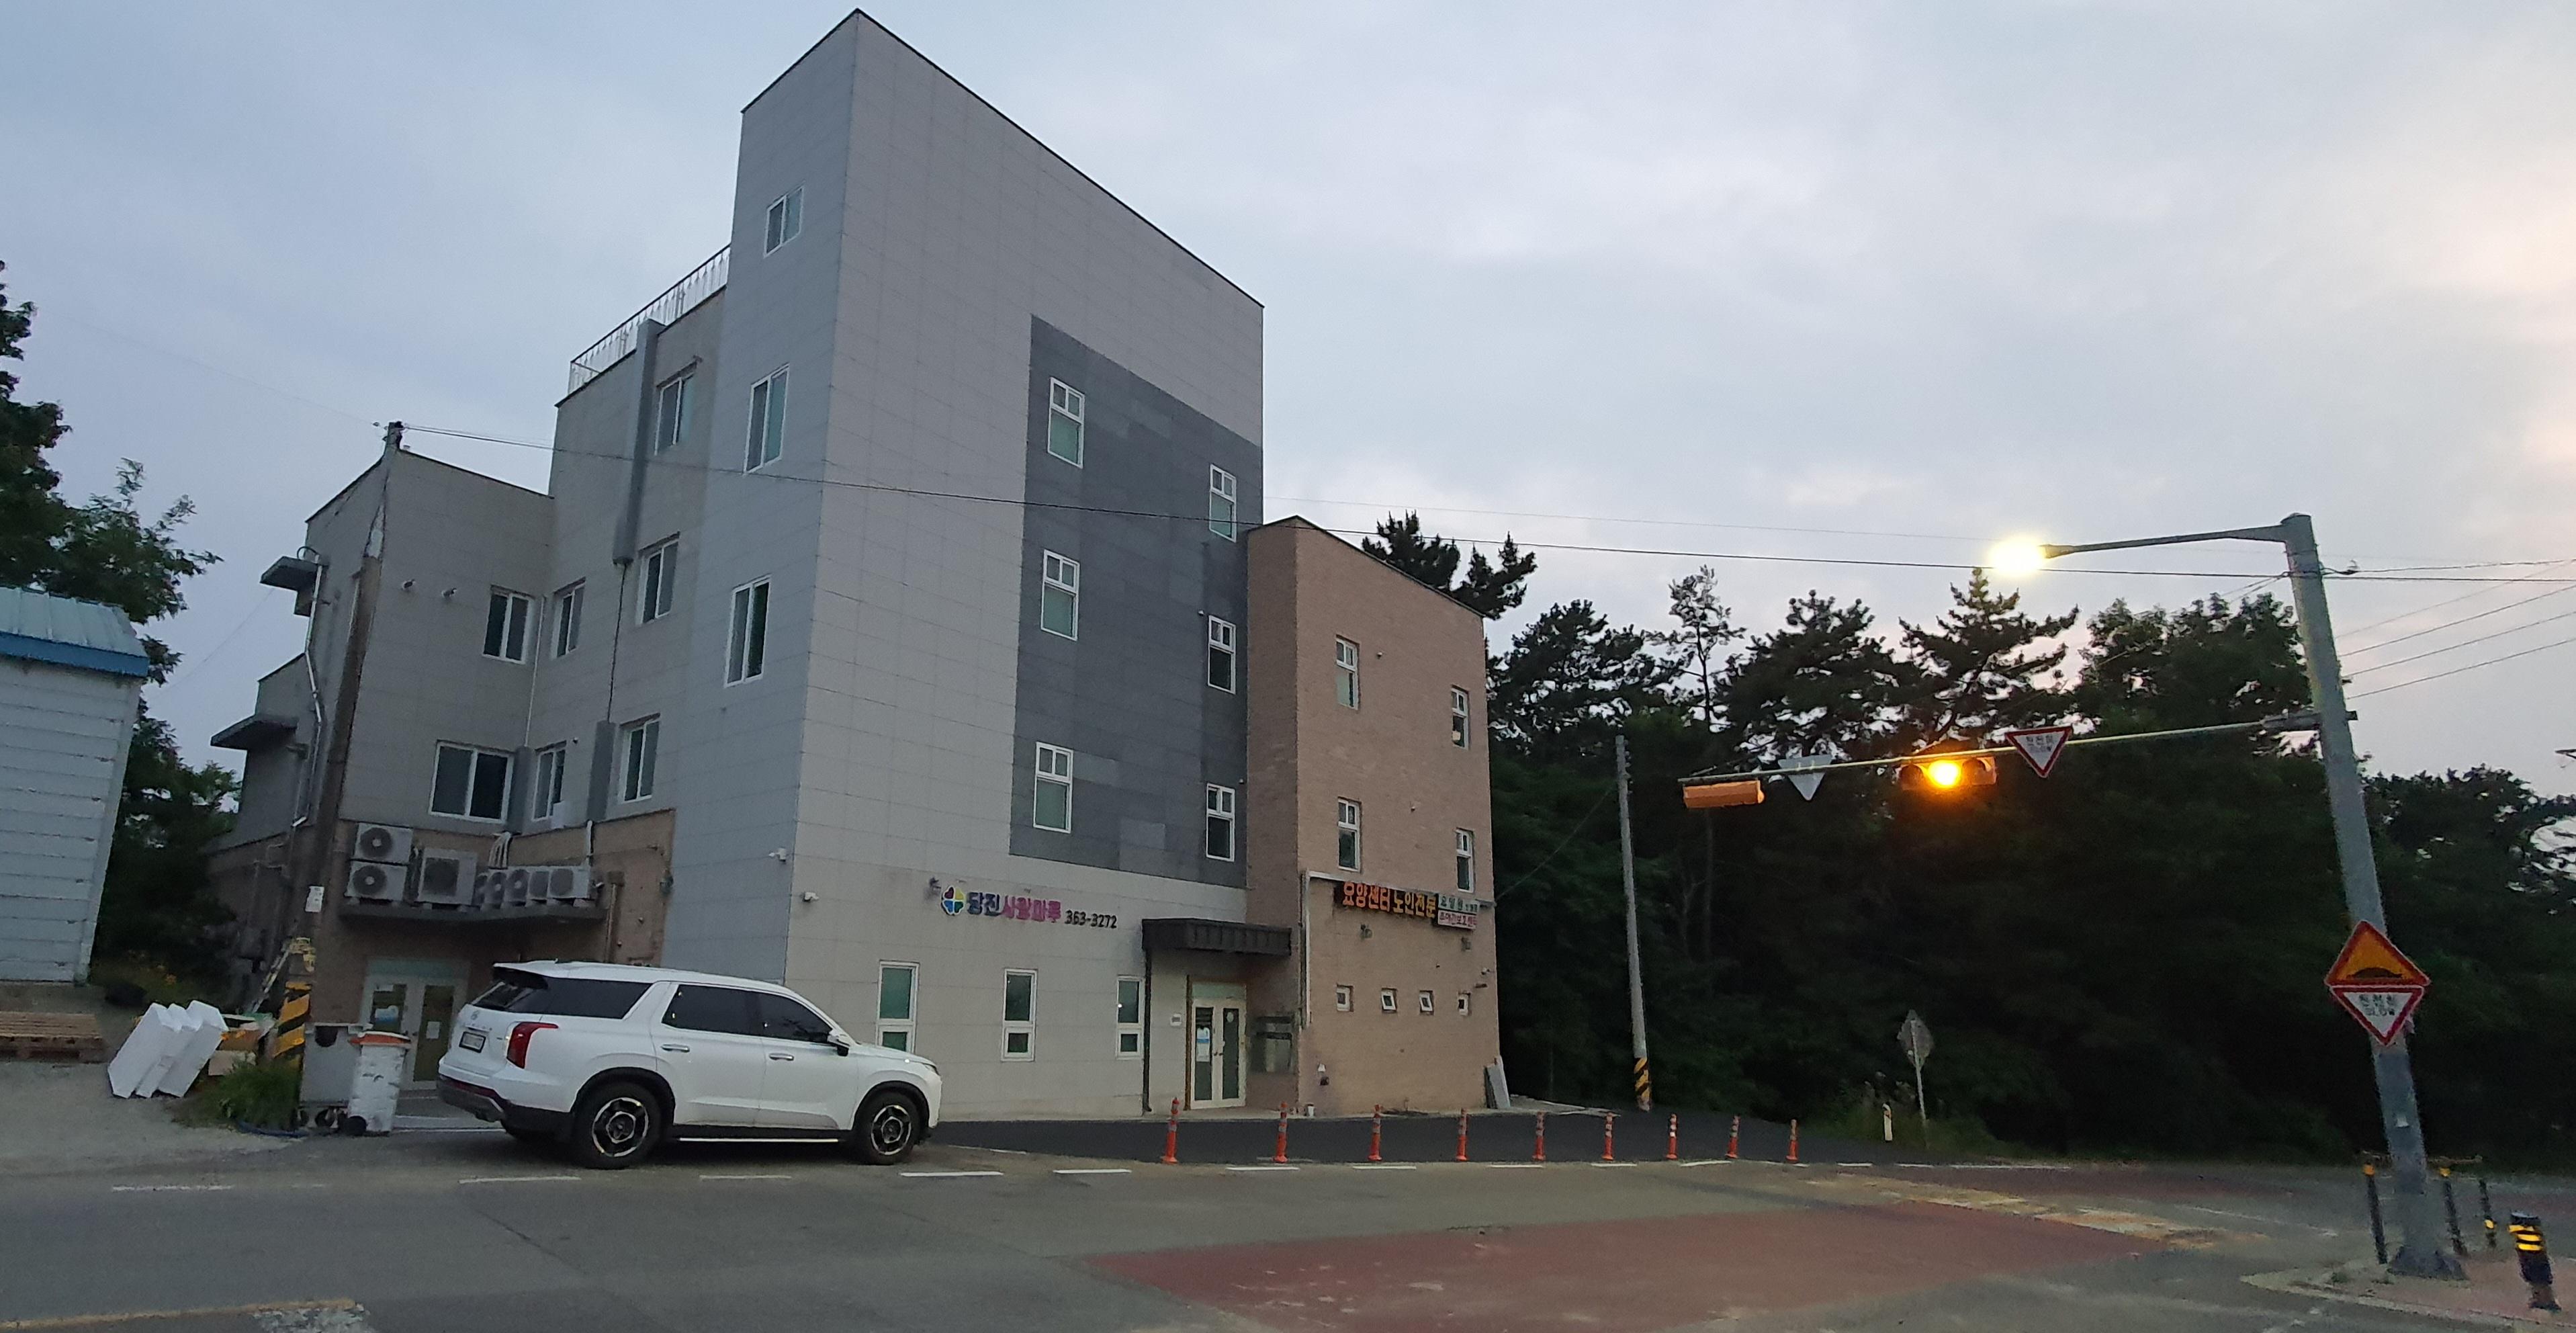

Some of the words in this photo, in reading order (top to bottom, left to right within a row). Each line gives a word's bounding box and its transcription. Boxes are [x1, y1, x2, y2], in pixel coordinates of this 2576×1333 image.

[1343, 881, 1390, 912] 요양센터
[1392, 890, 1437, 919] 노인전문
[1064, 909, 1118, 929] 363-3272
